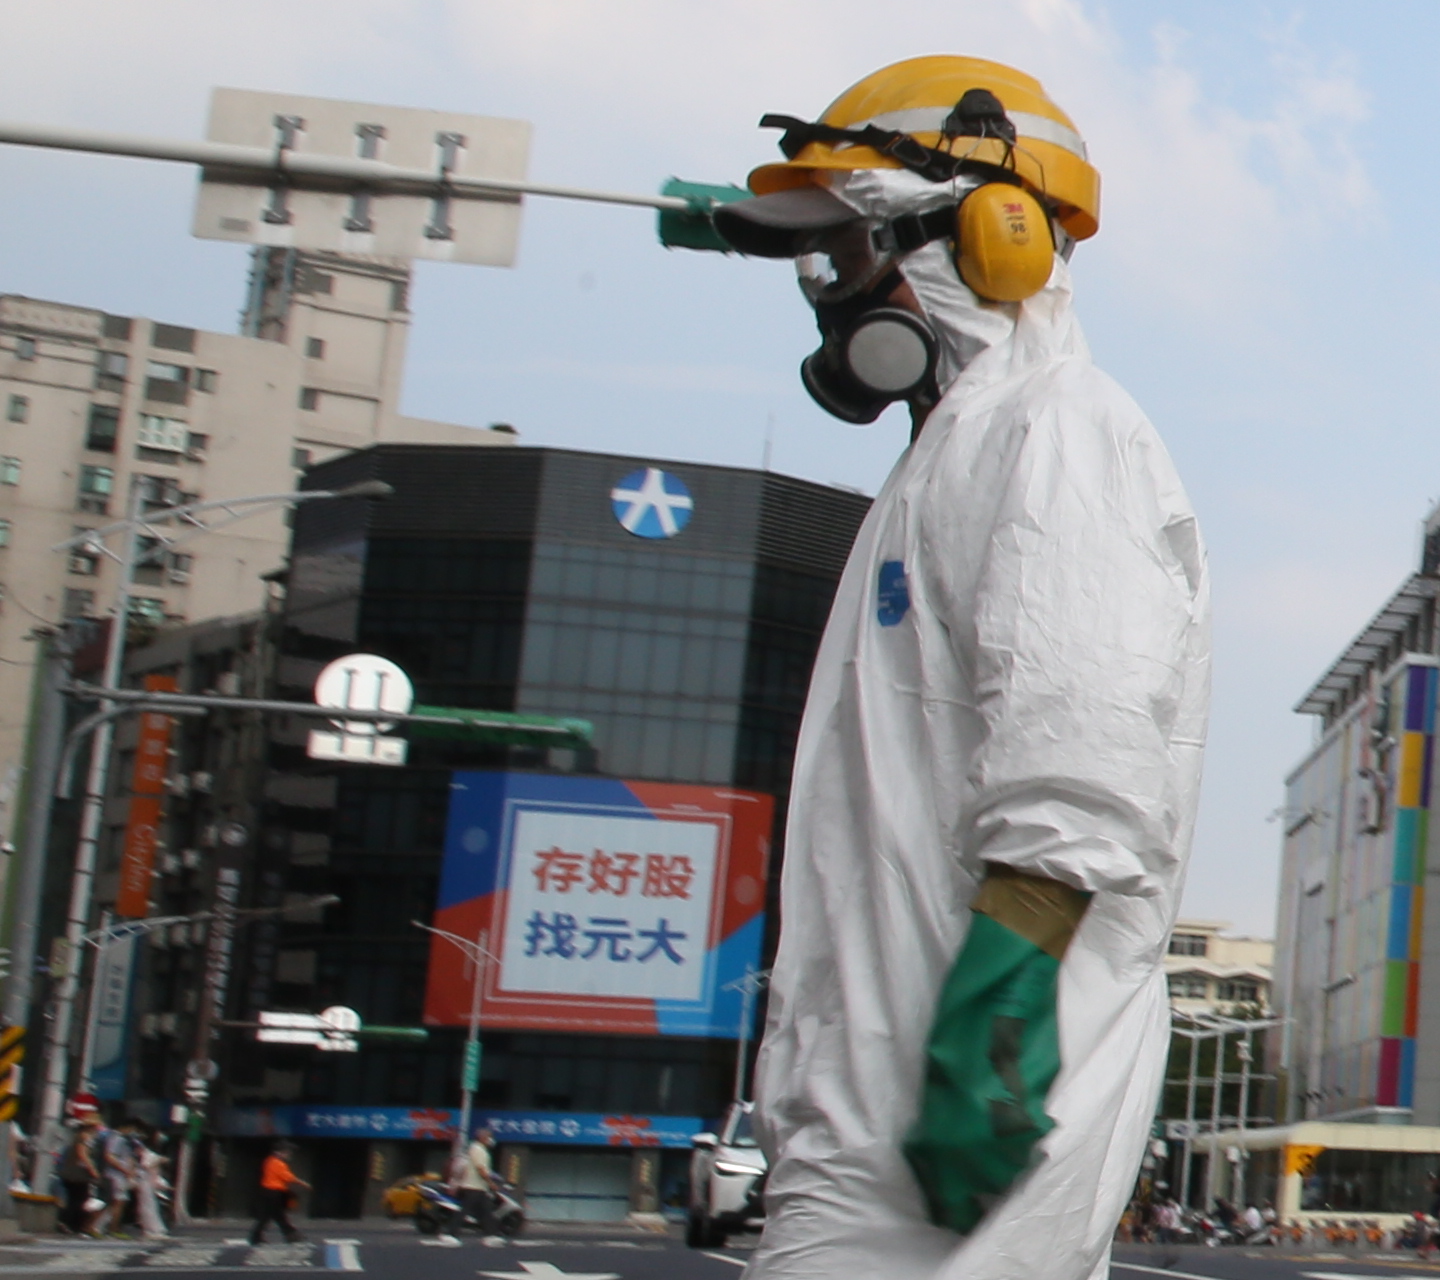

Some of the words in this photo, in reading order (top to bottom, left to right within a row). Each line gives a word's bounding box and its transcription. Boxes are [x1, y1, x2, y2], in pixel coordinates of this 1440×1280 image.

[531, 845, 696, 900] 存好股
[524, 909, 690, 966] 找元大
